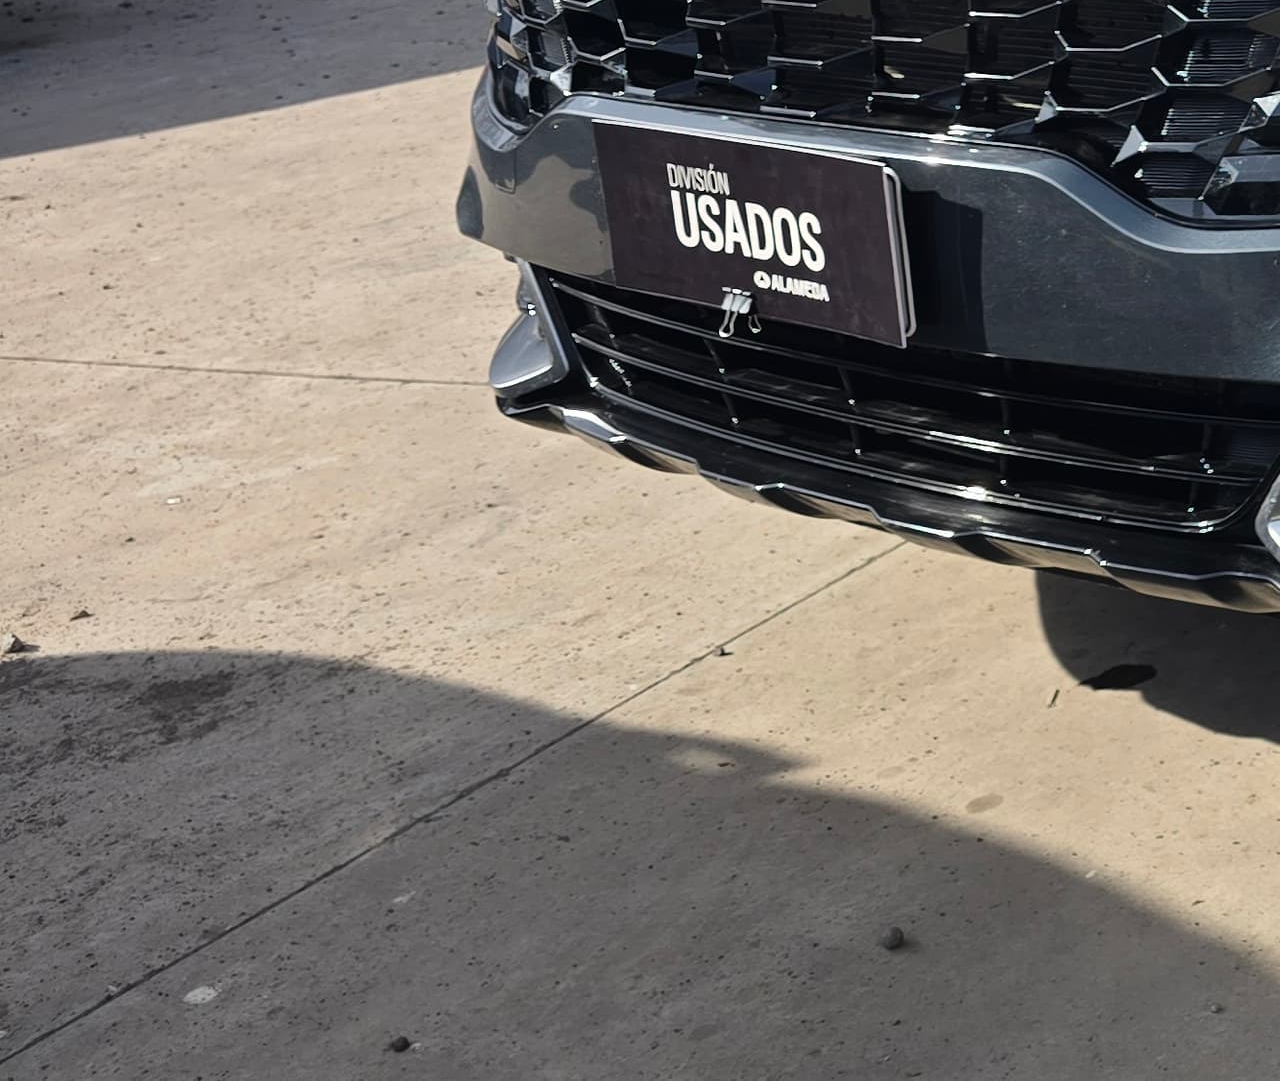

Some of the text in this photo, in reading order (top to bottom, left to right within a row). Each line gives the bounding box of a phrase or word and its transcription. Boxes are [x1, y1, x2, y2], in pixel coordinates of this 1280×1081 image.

[666, 162, 730, 196] DIVISIÓN
[670, 190, 826, 272] USADOS
[771, 274, 830, 302] ALAMEDA
